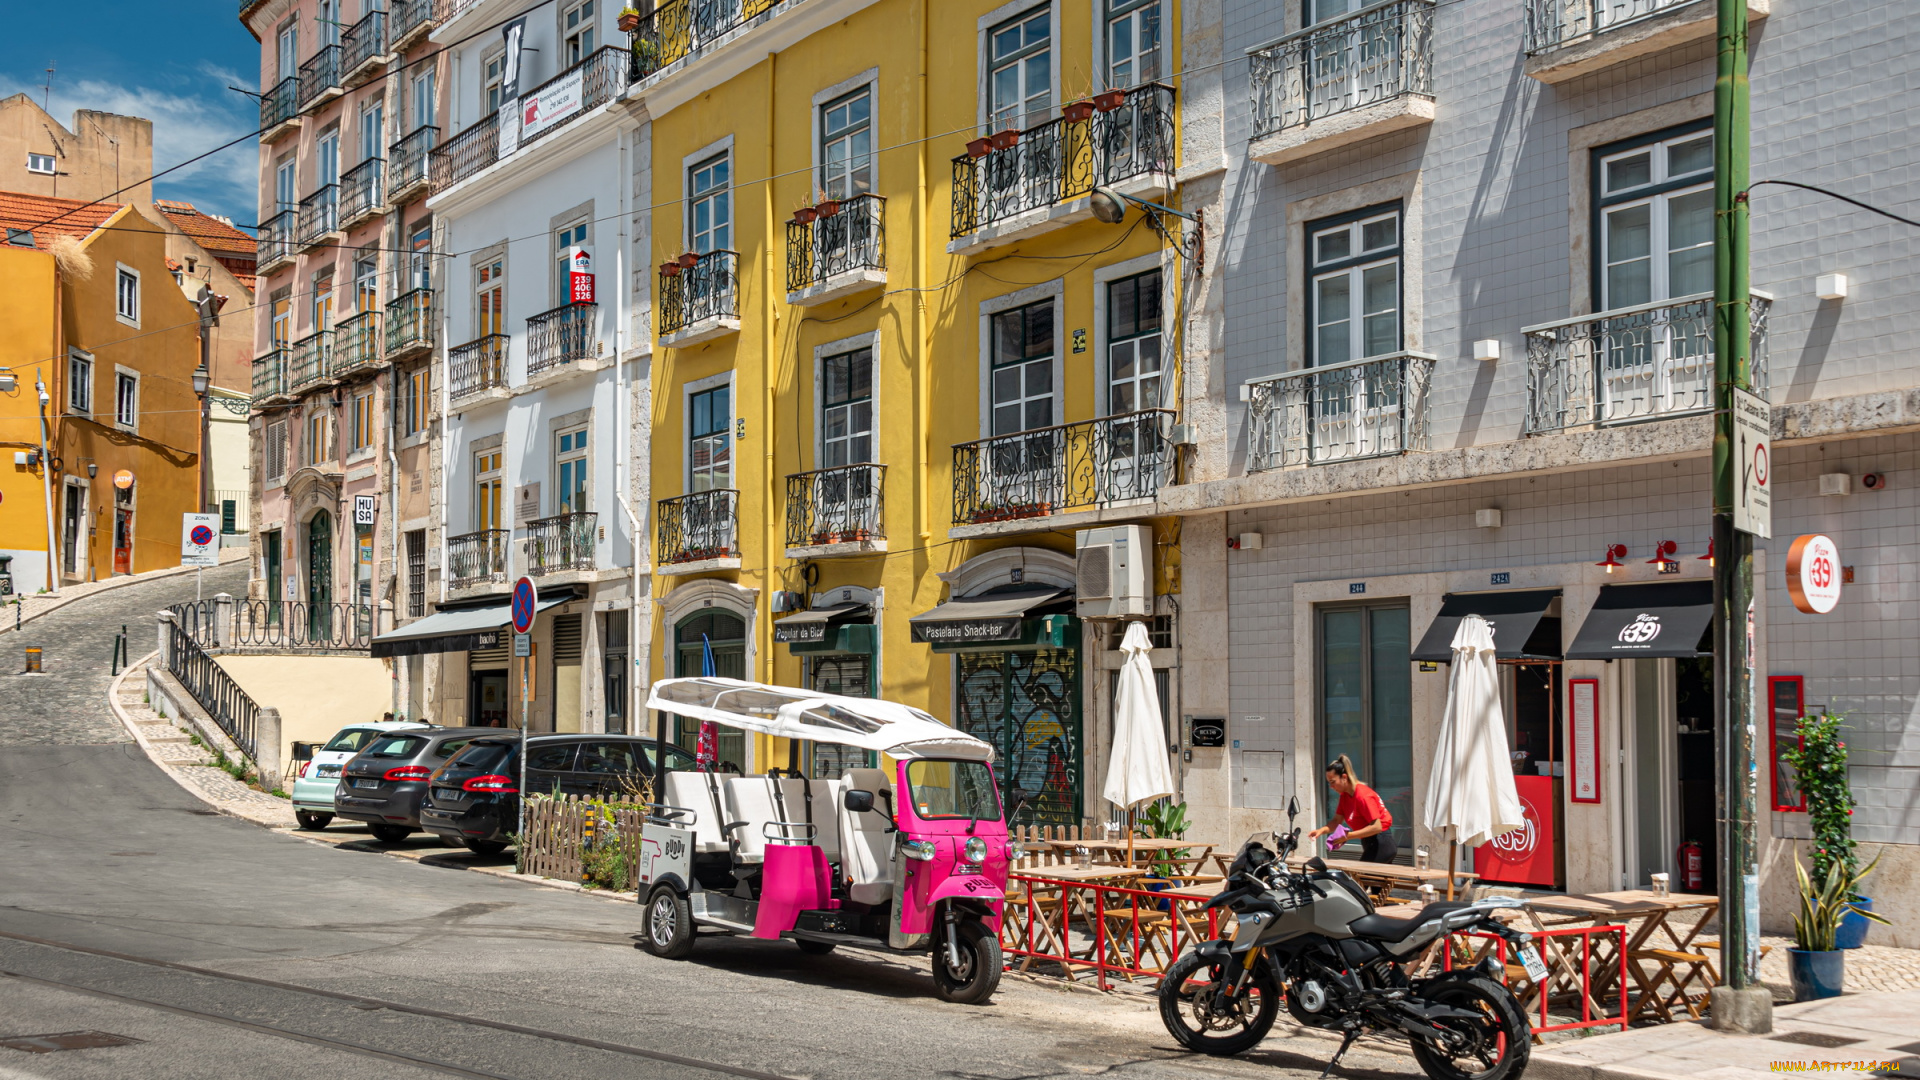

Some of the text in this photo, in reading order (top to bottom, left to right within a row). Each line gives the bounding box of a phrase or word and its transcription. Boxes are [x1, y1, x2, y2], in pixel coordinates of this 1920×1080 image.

[575, 276, 591, 284] 239
[575, 284, 591, 292] 406
[575, 292, 591, 300] 326
[1351, 584, 1363, 592] 244
[776, 626, 823, 640] Popular da Bica
[926, 623, 1003, 638] Pastelaria Snack-bar
[665, 839, 685, 857] BUDDY
